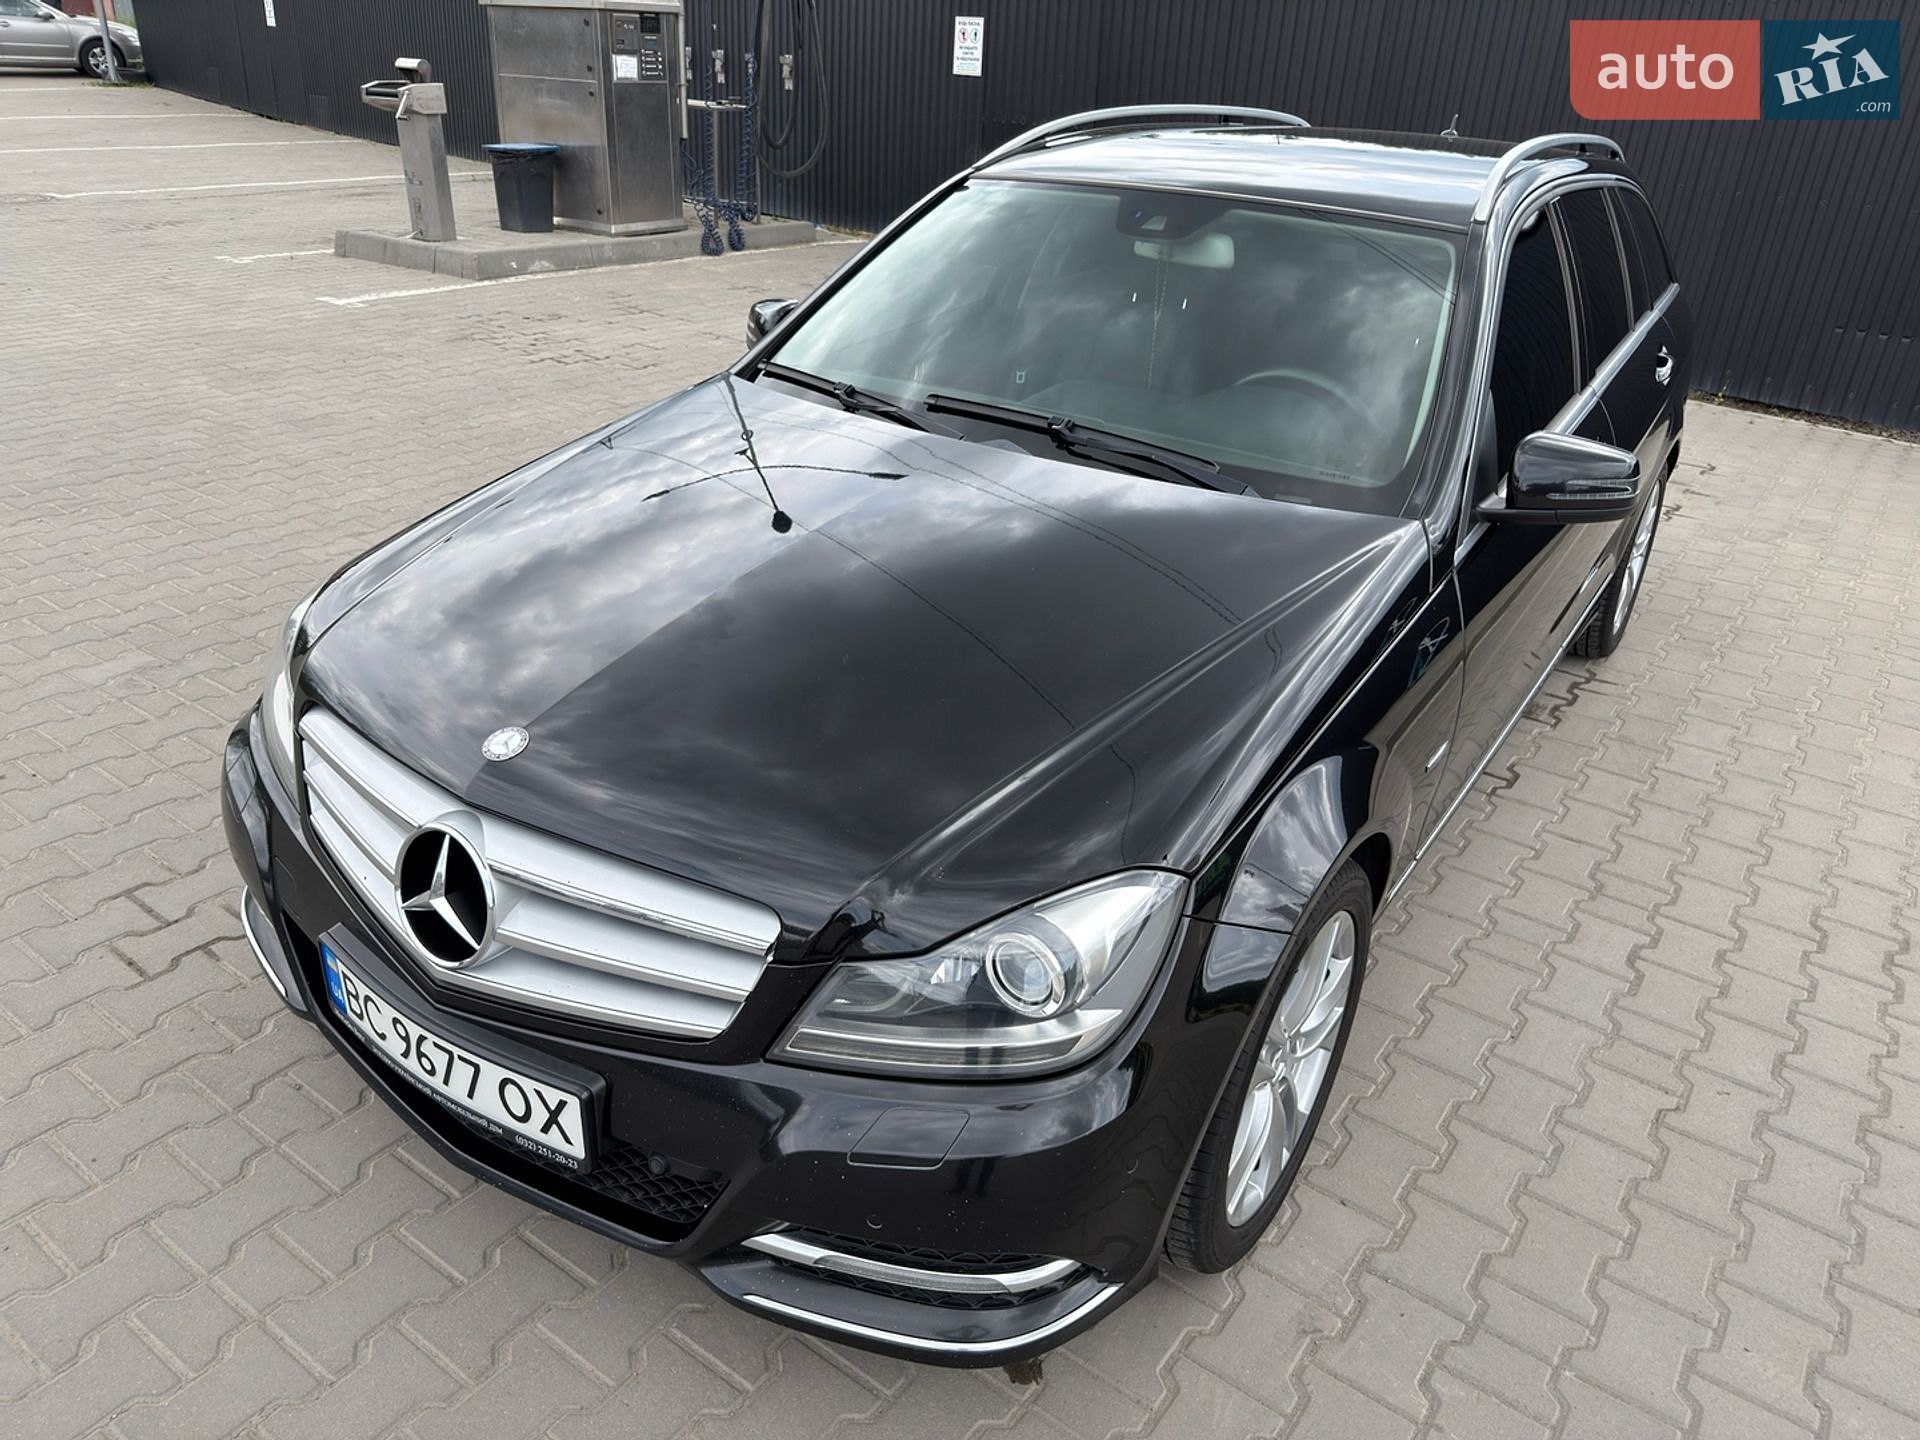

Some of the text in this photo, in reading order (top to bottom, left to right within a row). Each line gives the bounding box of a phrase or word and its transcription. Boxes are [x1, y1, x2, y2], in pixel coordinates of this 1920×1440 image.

[341, 970, 387, 1042] BC
[392, 1016, 481, 1101] 9677
[498, 1077, 576, 1147] OX
